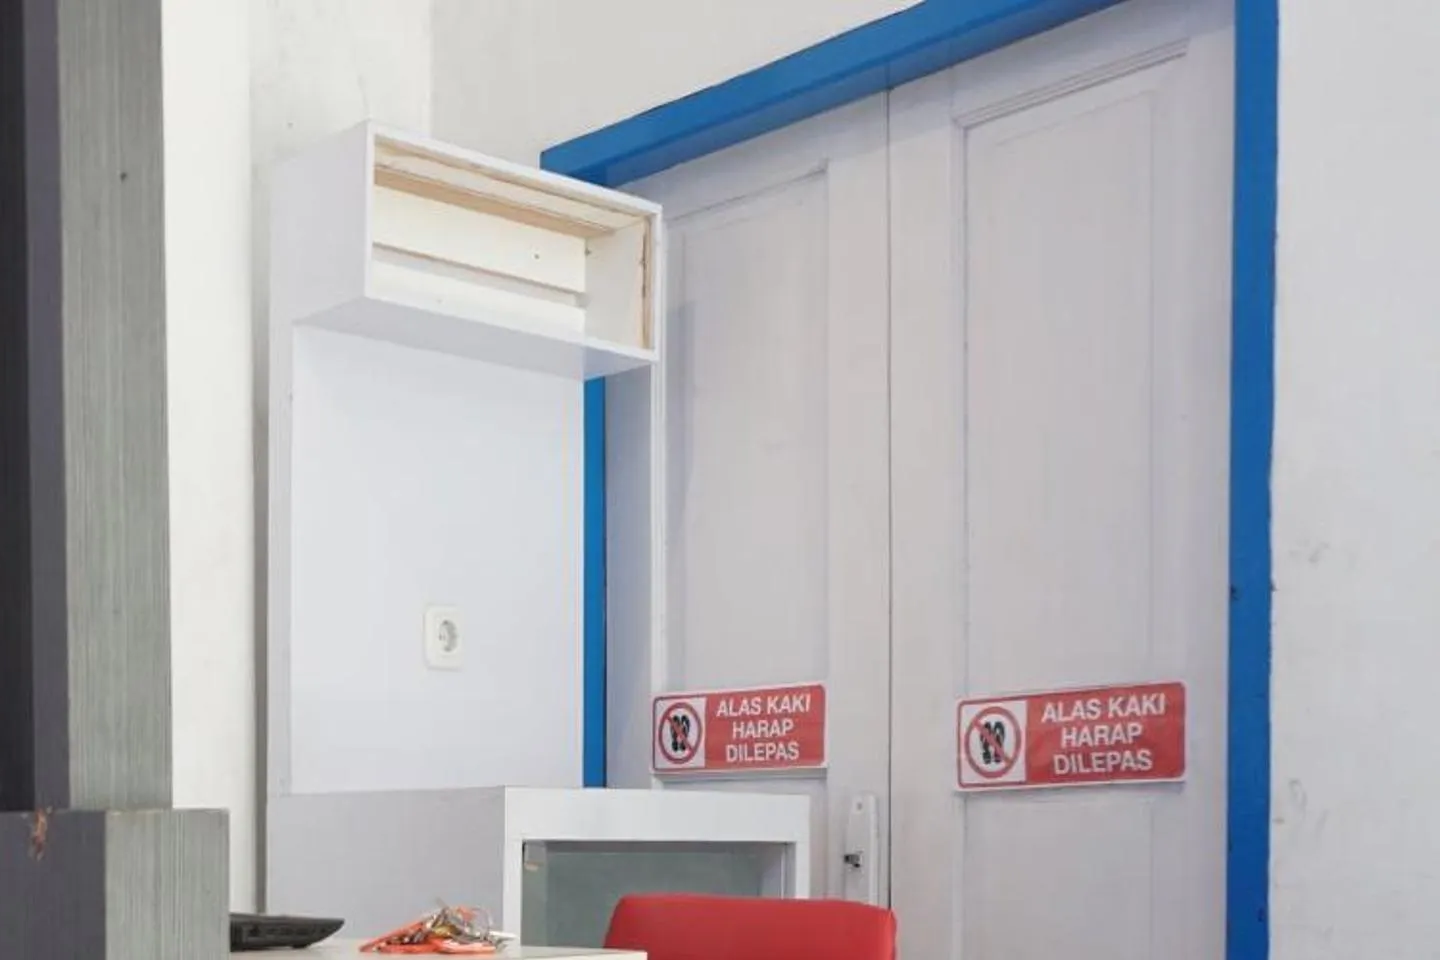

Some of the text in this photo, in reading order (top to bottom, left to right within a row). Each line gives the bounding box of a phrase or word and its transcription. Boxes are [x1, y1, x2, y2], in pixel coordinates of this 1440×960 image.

[716, 694, 811, 717] ALAS KAKI
[1041, 694, 1165, 723] ALAS KAKI
[732, 719, 794, 739] HARAP
[1061, 722, 1143, 748] HARAP
[725, 742, 800, 762] DILEPAS
[1054, 750, 1152, 775] DILEPAS
